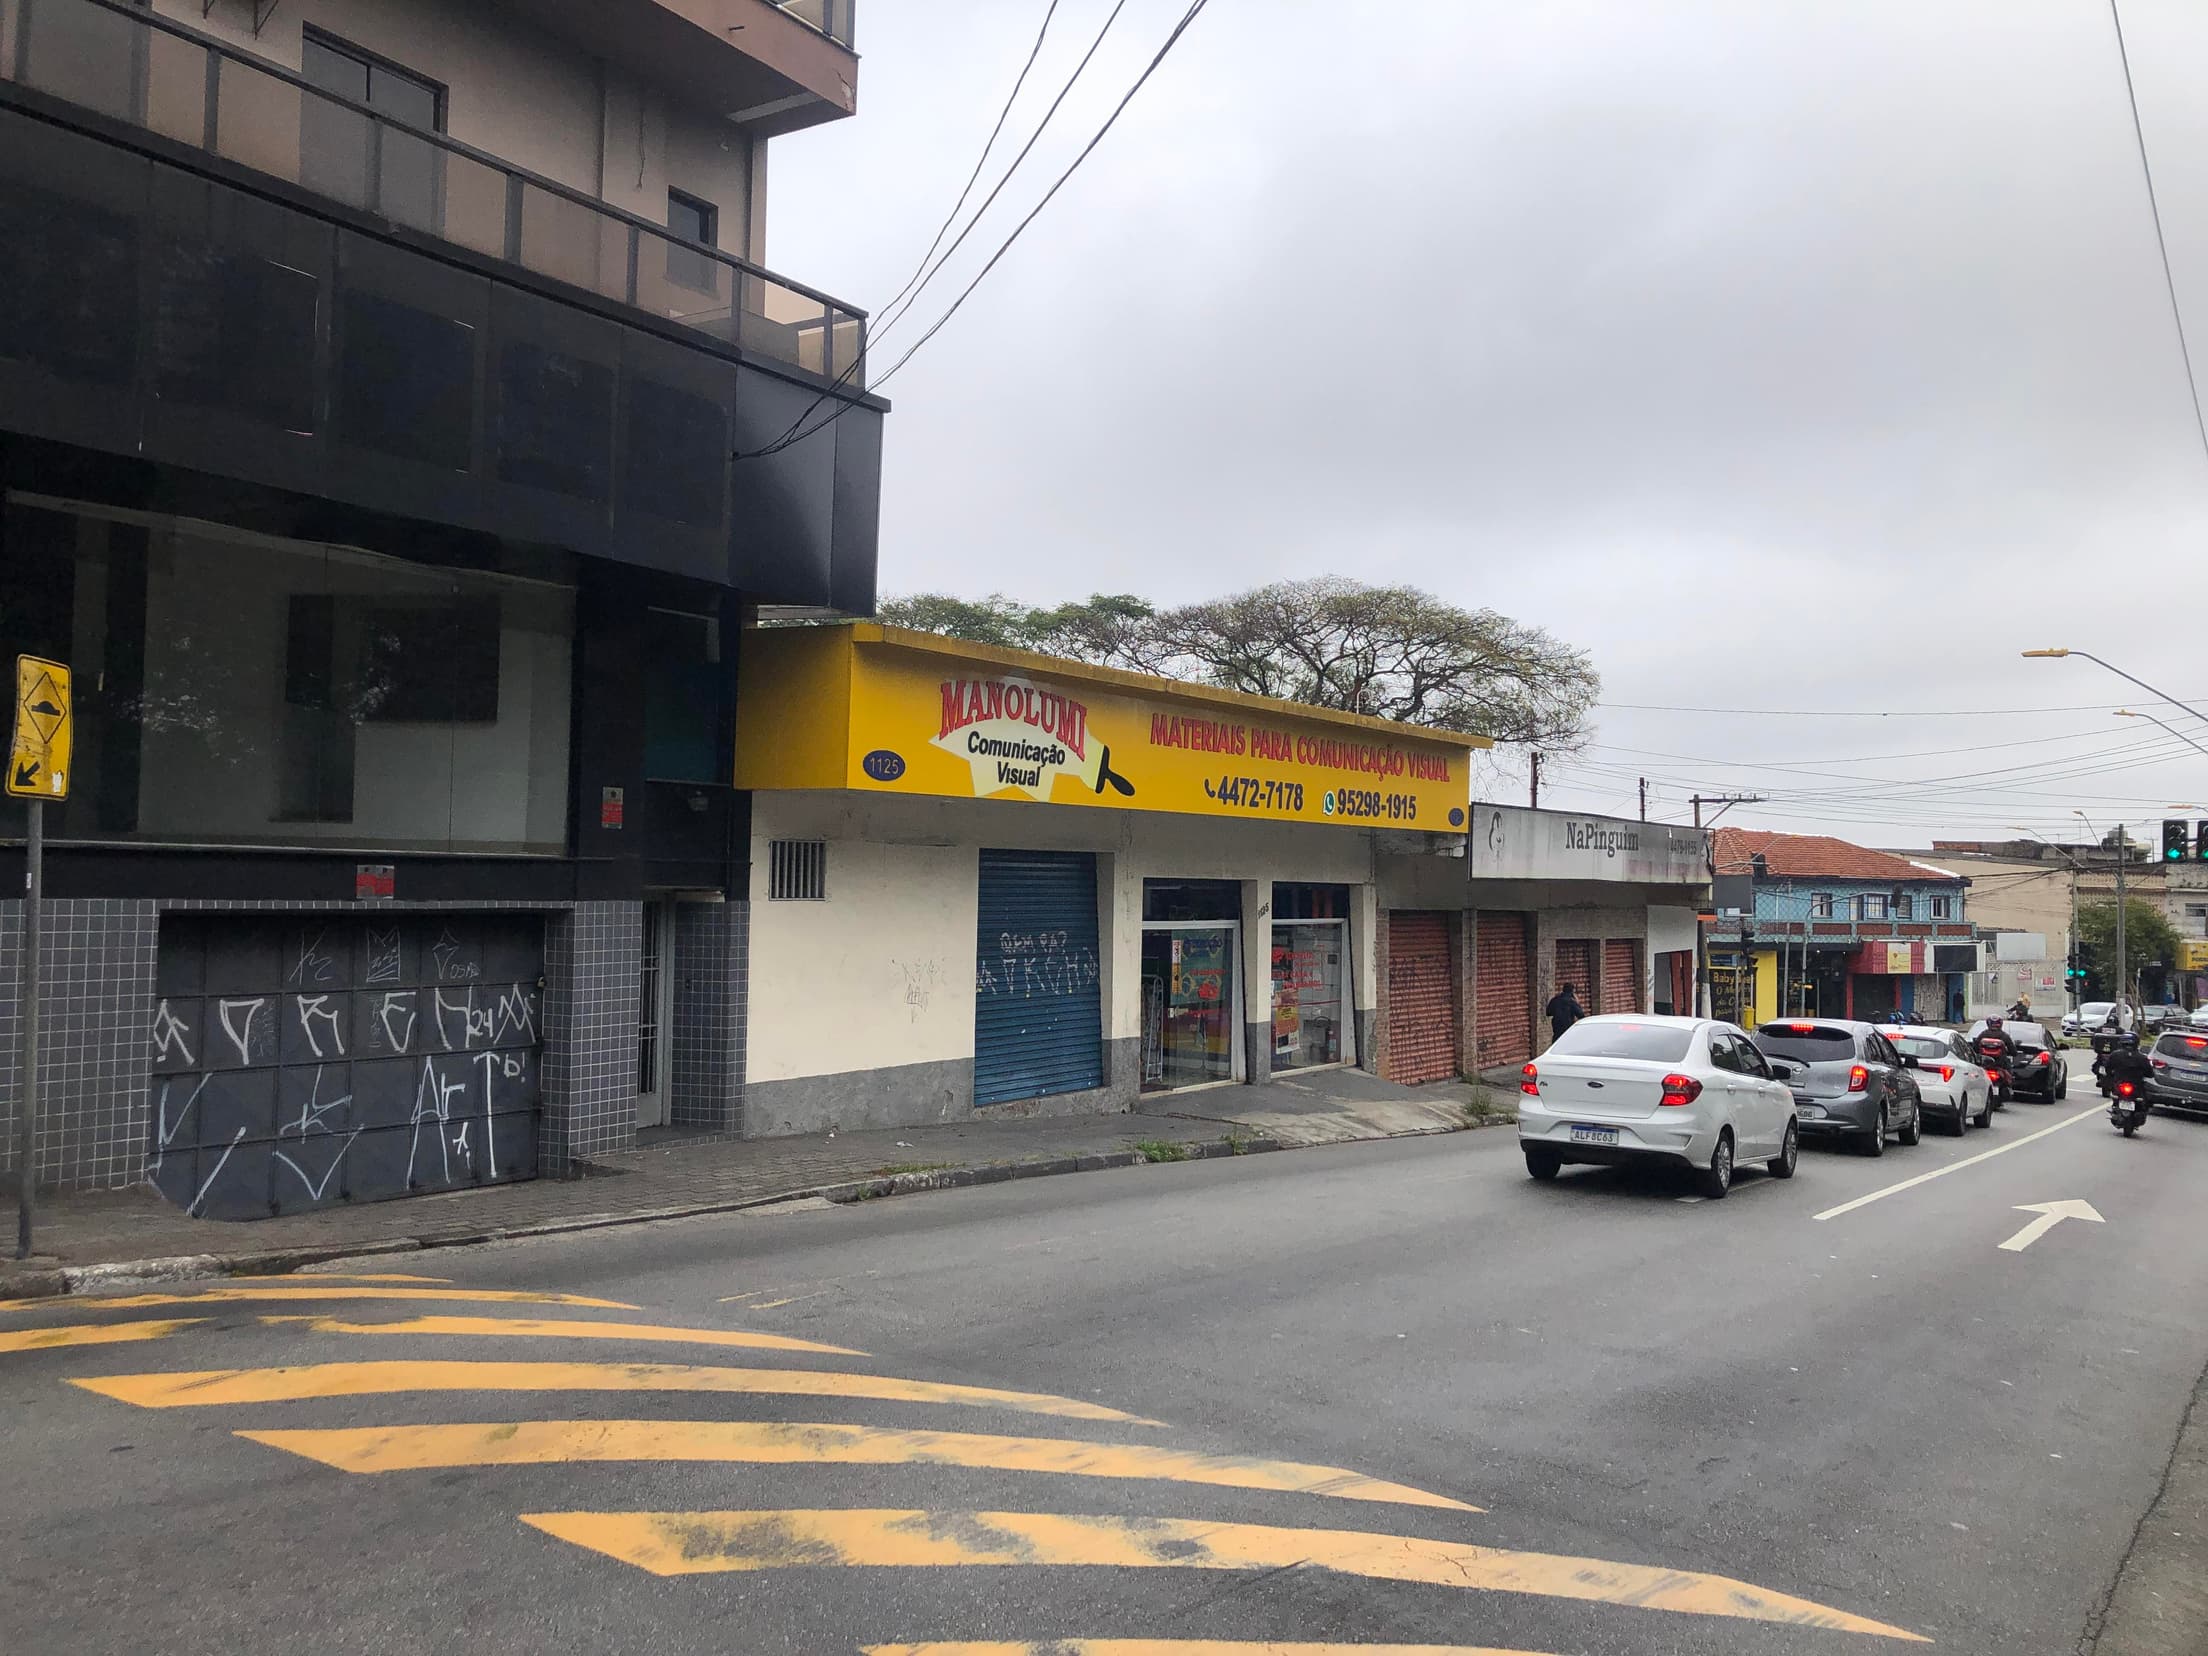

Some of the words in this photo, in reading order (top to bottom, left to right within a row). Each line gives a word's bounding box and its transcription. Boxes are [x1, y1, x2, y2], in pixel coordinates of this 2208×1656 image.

[939, 680, 1088, 762] MANOLUMI
[869, 757, 899, 775] 1125
[968, 731, 1066, 768] Comunicação
[1150, 713, 1246, 756] MATERIAIS
[1251, 727, 1293, 762] PARA
[1297, 735, 1405, 782] COMUNICAÇÃO
[1408, 752, 1450, 783] VISUAL
[997, 761, 1041, 787] Visual
[1217, 775, 1304, 812] 4472-7178
[1337, 788, 1417, 821] 95298-1915
[1566, 821, 1640, 858] NaPinguim
